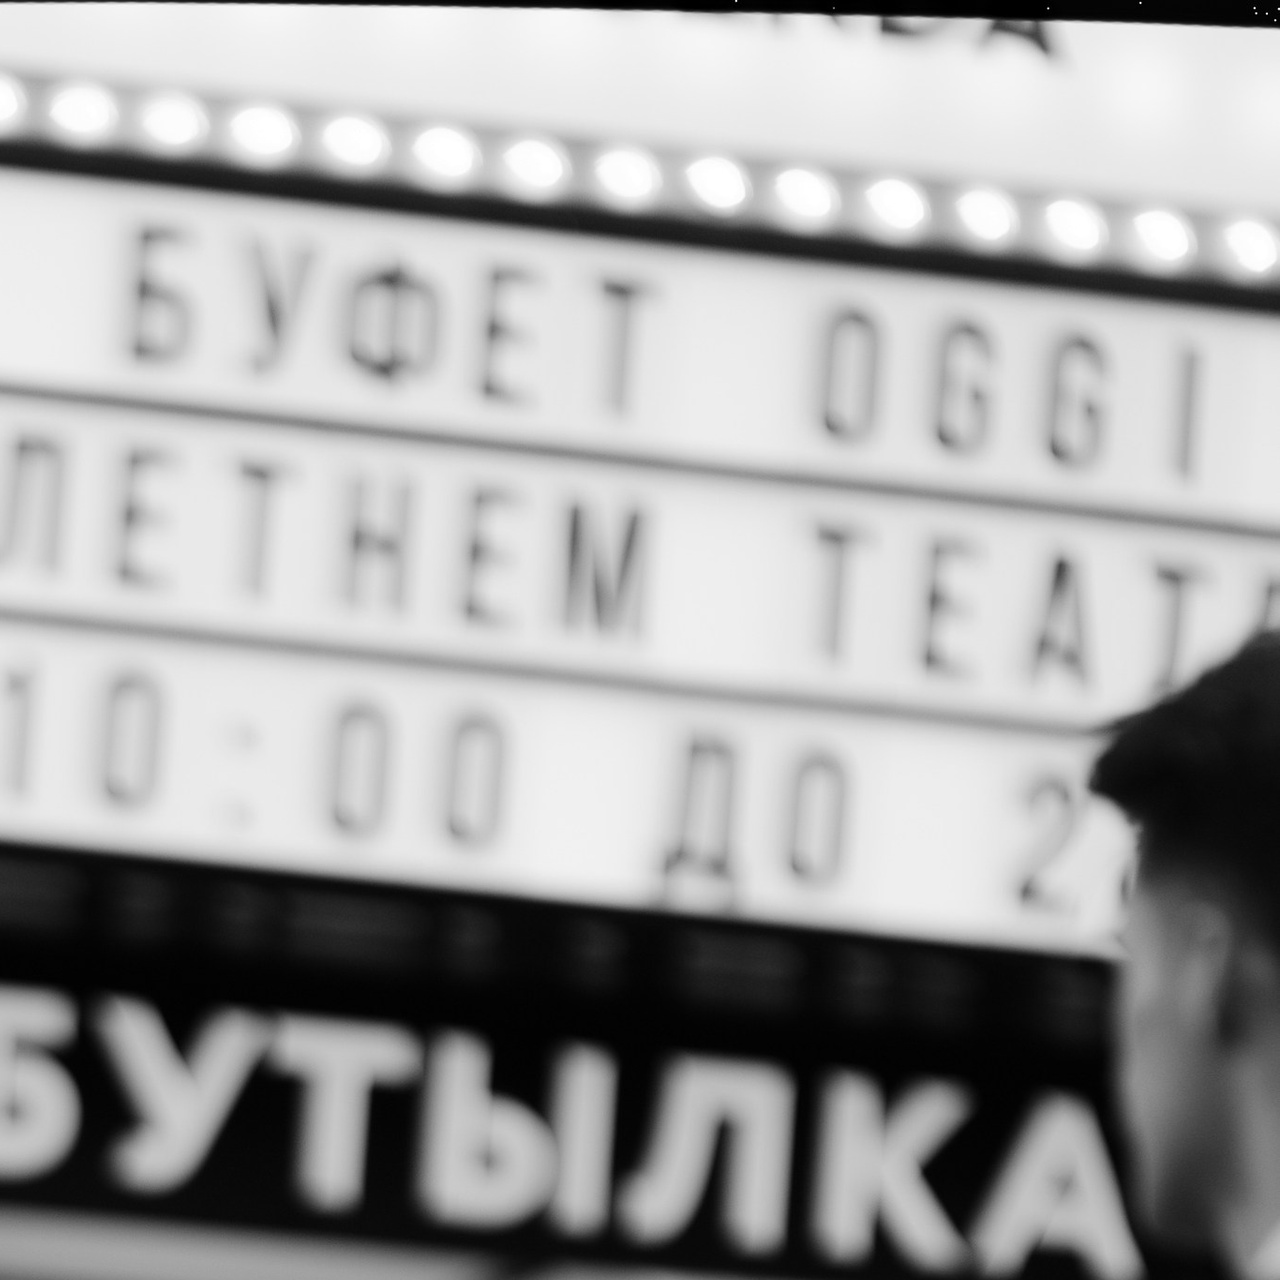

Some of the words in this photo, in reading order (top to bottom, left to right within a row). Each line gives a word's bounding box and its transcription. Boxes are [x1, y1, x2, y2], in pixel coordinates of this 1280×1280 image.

[128, 222, 662, 420] БУФЕТ
[812, 298, 1208, 482] OGGI
[654, 732, 852, 915] ДО
